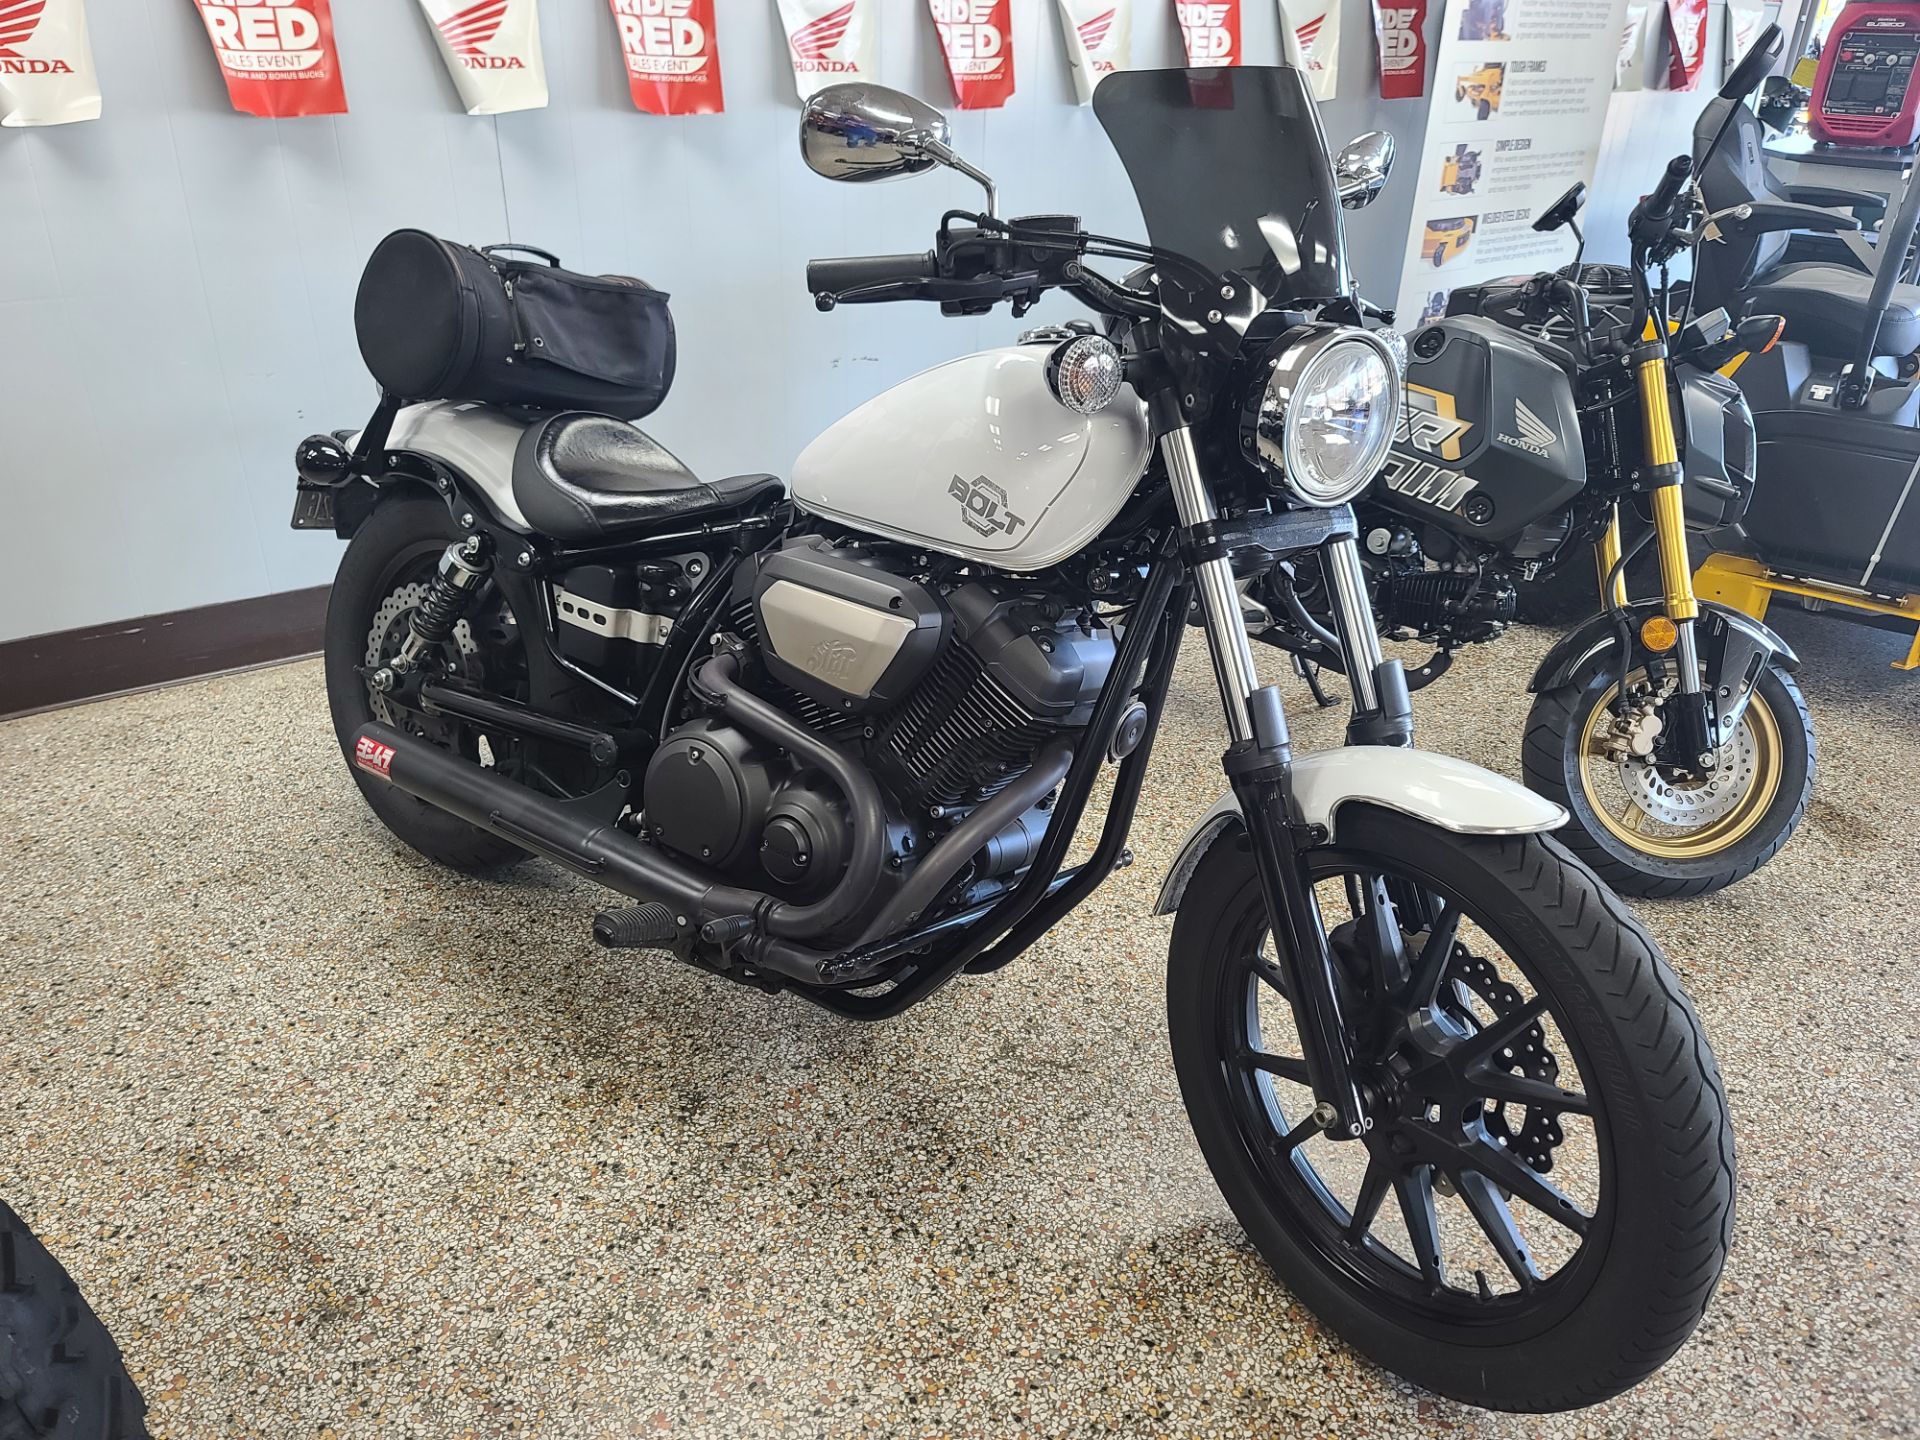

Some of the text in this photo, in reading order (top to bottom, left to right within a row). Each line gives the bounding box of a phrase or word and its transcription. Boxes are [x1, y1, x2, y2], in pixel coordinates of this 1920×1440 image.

[201, 4, 319, 50] RED
[618, 14, 705, 56] RED
[0, 59, 75, 73] NDA
[257, 55, 303, 67] EVENT
[793, 61, 860, 72] HONDA
[1496, 432, 1550, 459] HONDA
[948, 474, 1026, 535] BOLT
